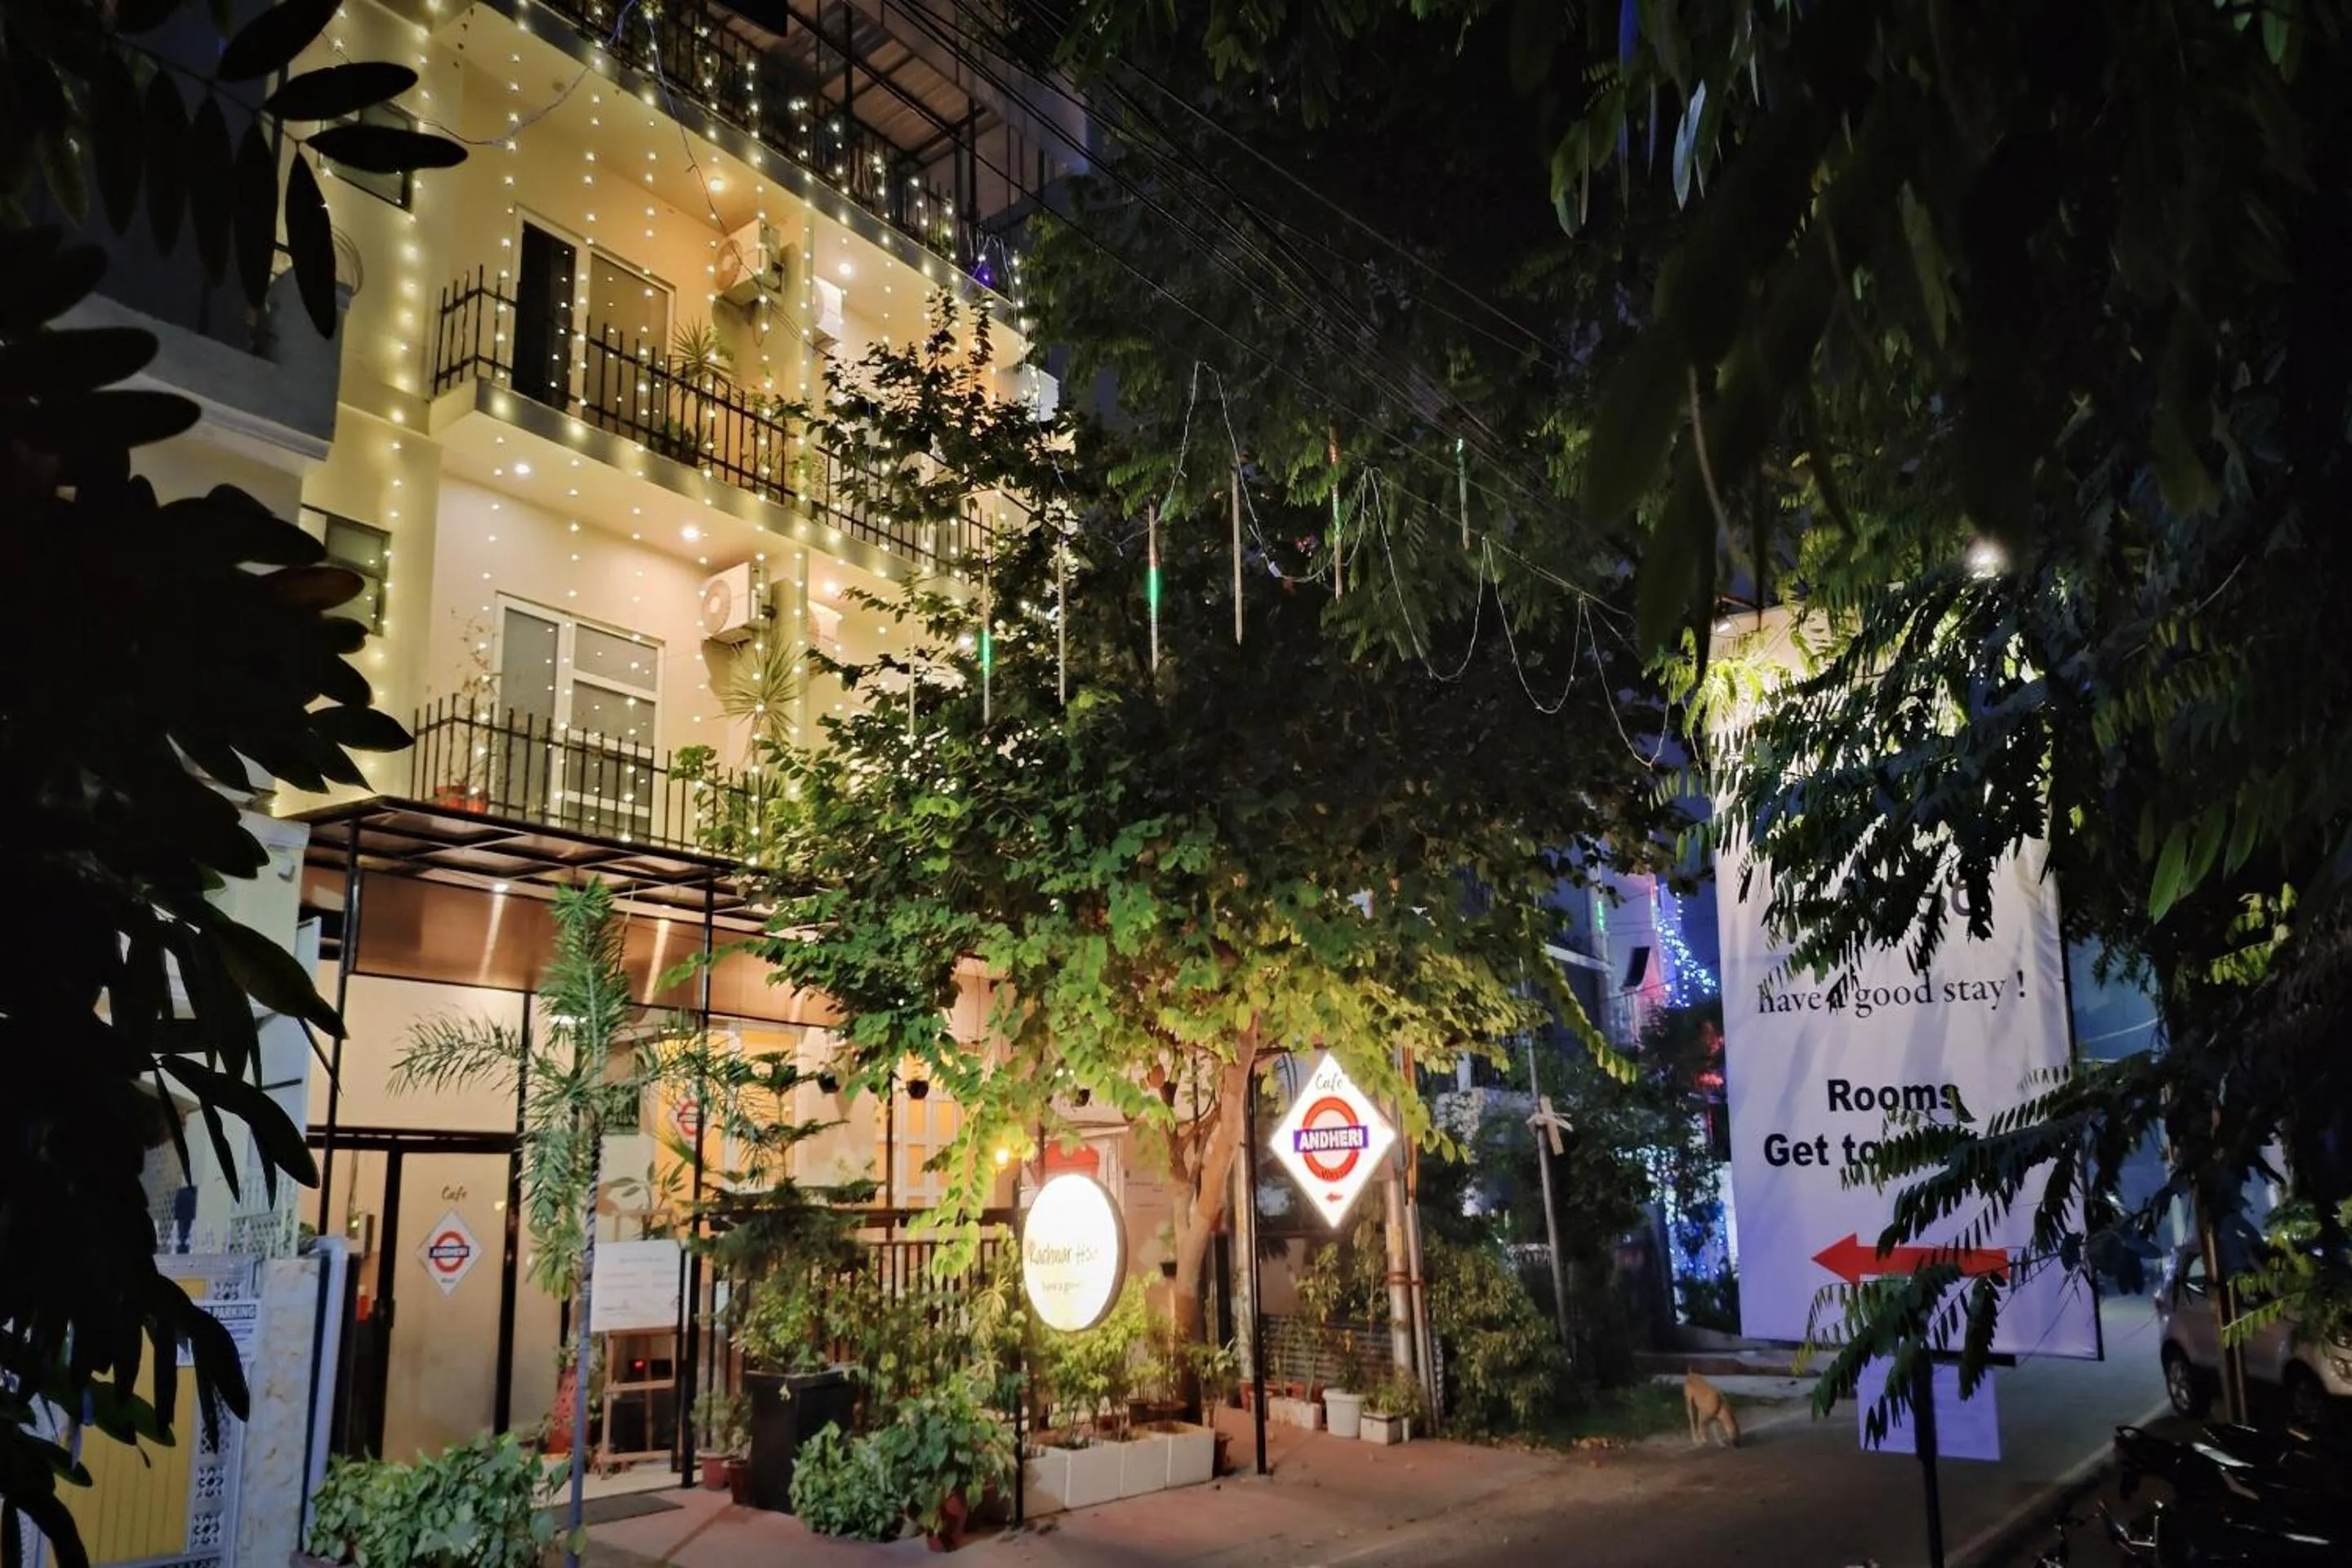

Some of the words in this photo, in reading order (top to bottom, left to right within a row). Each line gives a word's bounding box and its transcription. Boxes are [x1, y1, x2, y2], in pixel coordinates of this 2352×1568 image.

[1757, 981, 1821, 1013] have
[1855, 969, 1934, 1018] good
[1943, 979, 2006, 1011] stay
[1315, 1071, 1343, 1092] Cafe
[1827, 1079, 1960, 1111] Rooms
[1299, 1129, 1363, 1151] ANDHERI
[1763, 1133, 1829, 1167] Get
[441, 1185, 467, 1201] Cafe
